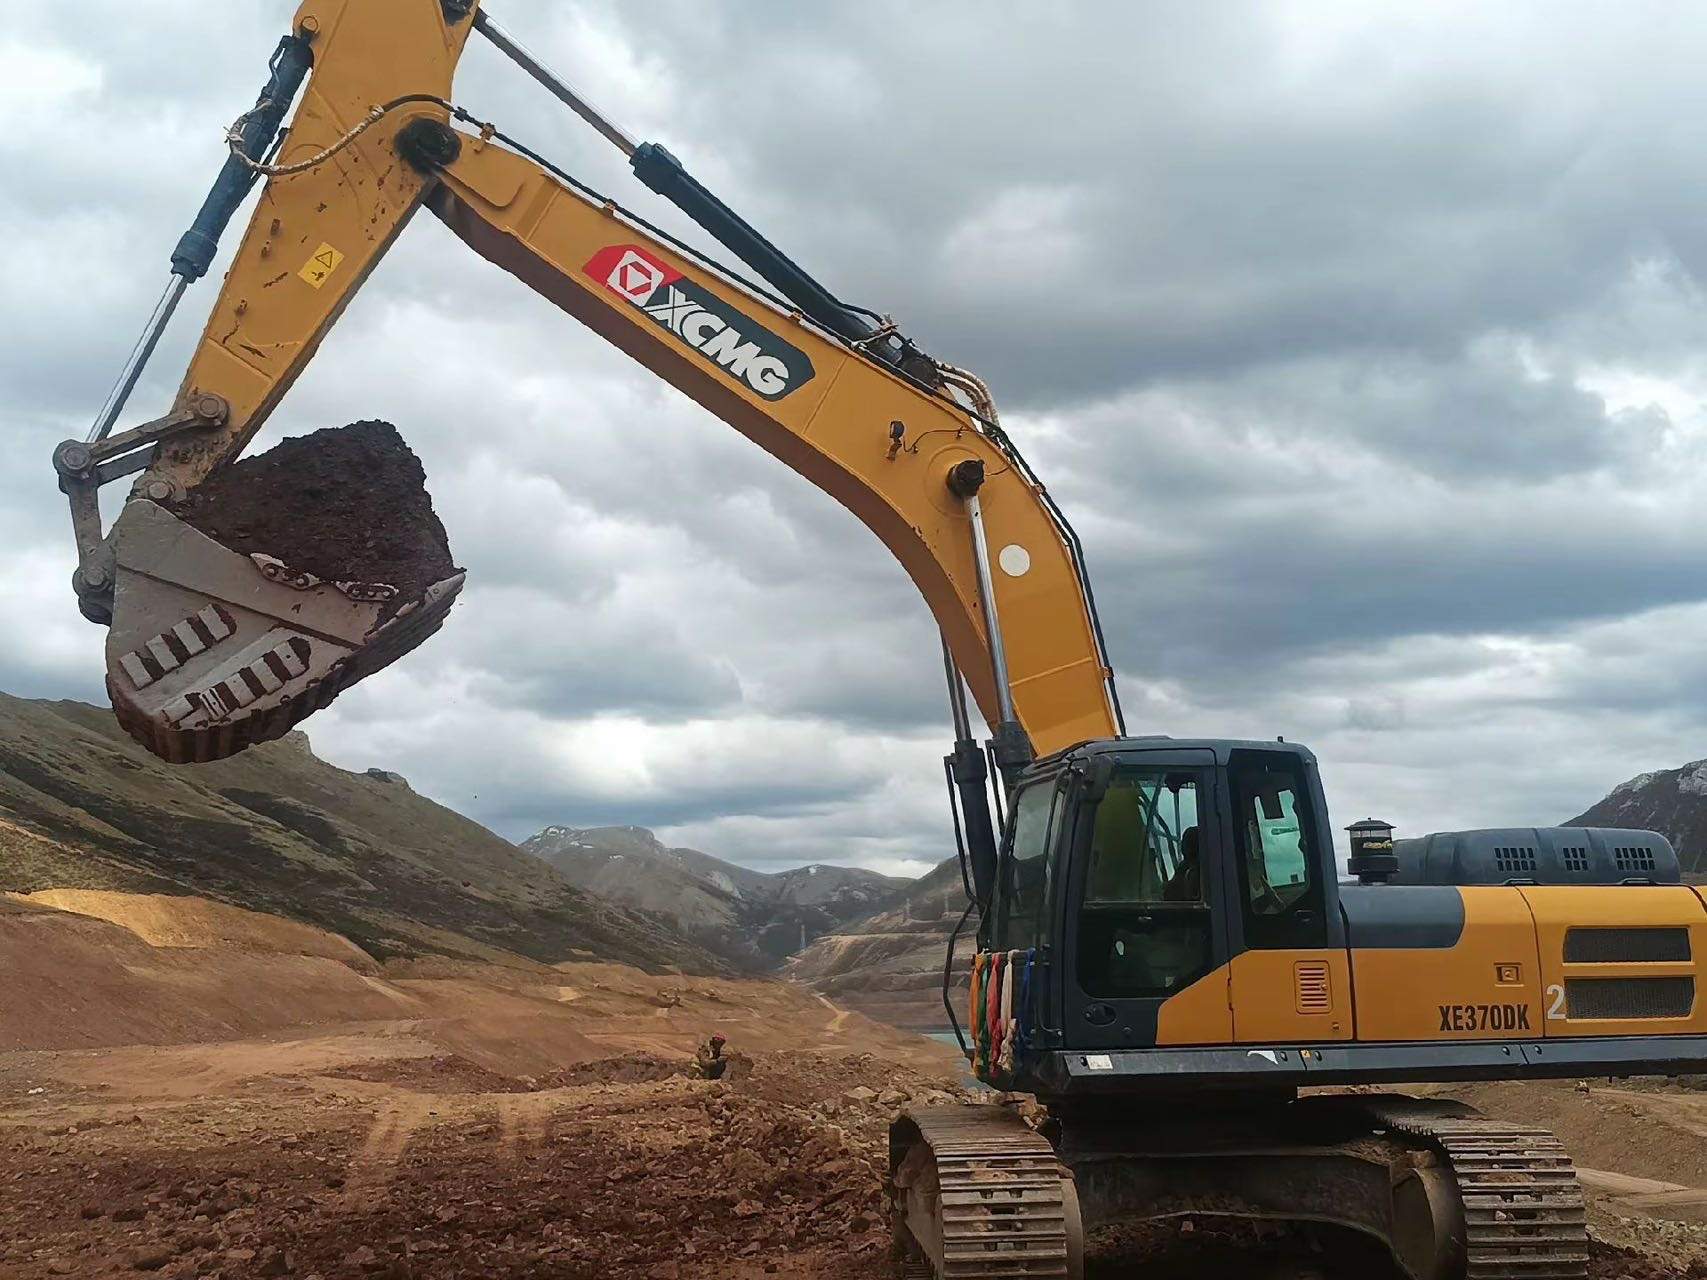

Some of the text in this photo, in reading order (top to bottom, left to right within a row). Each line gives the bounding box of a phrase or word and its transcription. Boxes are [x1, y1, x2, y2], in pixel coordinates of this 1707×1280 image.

[643, 285, 789, 395] XCMG
[1438, 1004, 1531, 1031] XE370DK
[1546, 984, 1567, 1020] 2
